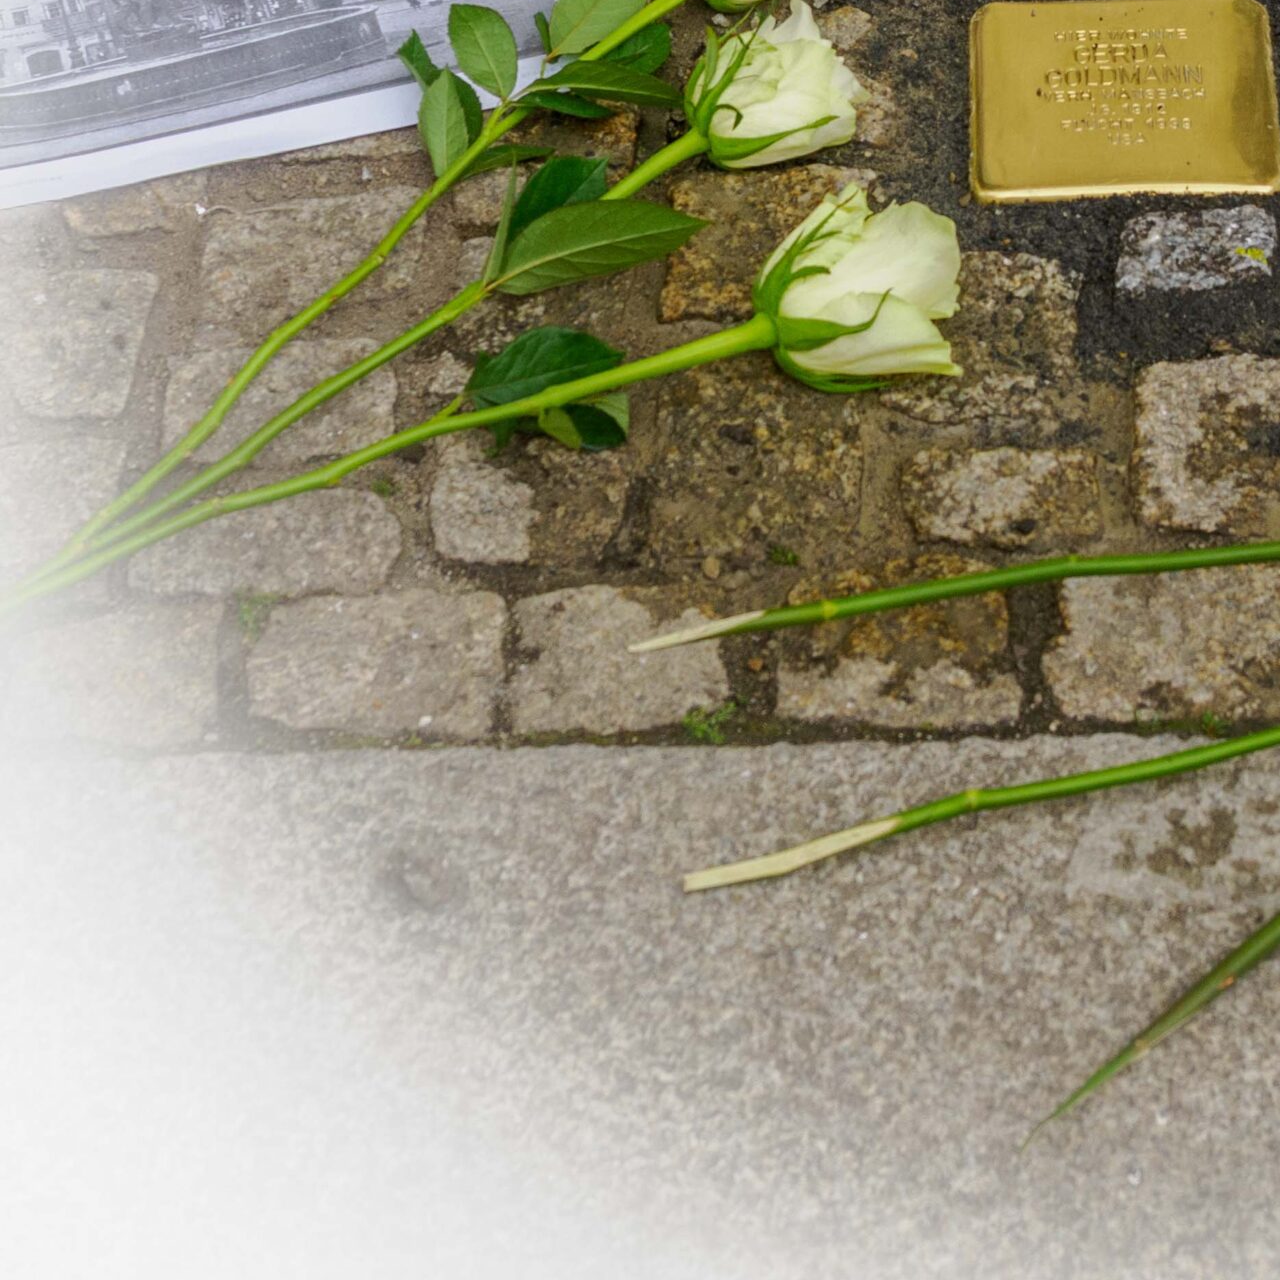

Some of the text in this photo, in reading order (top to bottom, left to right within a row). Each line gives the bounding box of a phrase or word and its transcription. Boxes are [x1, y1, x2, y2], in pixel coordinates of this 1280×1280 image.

[1054, 28, 1189, 42] HIER WOHNTE
[1073, 42, 1168, 65] GERDA
[1044, 63, 1204, 88] GOLDMANN
[1061, 119, 1134, 132] FLUCHT
[1107, 132, 1147, 145] USA
